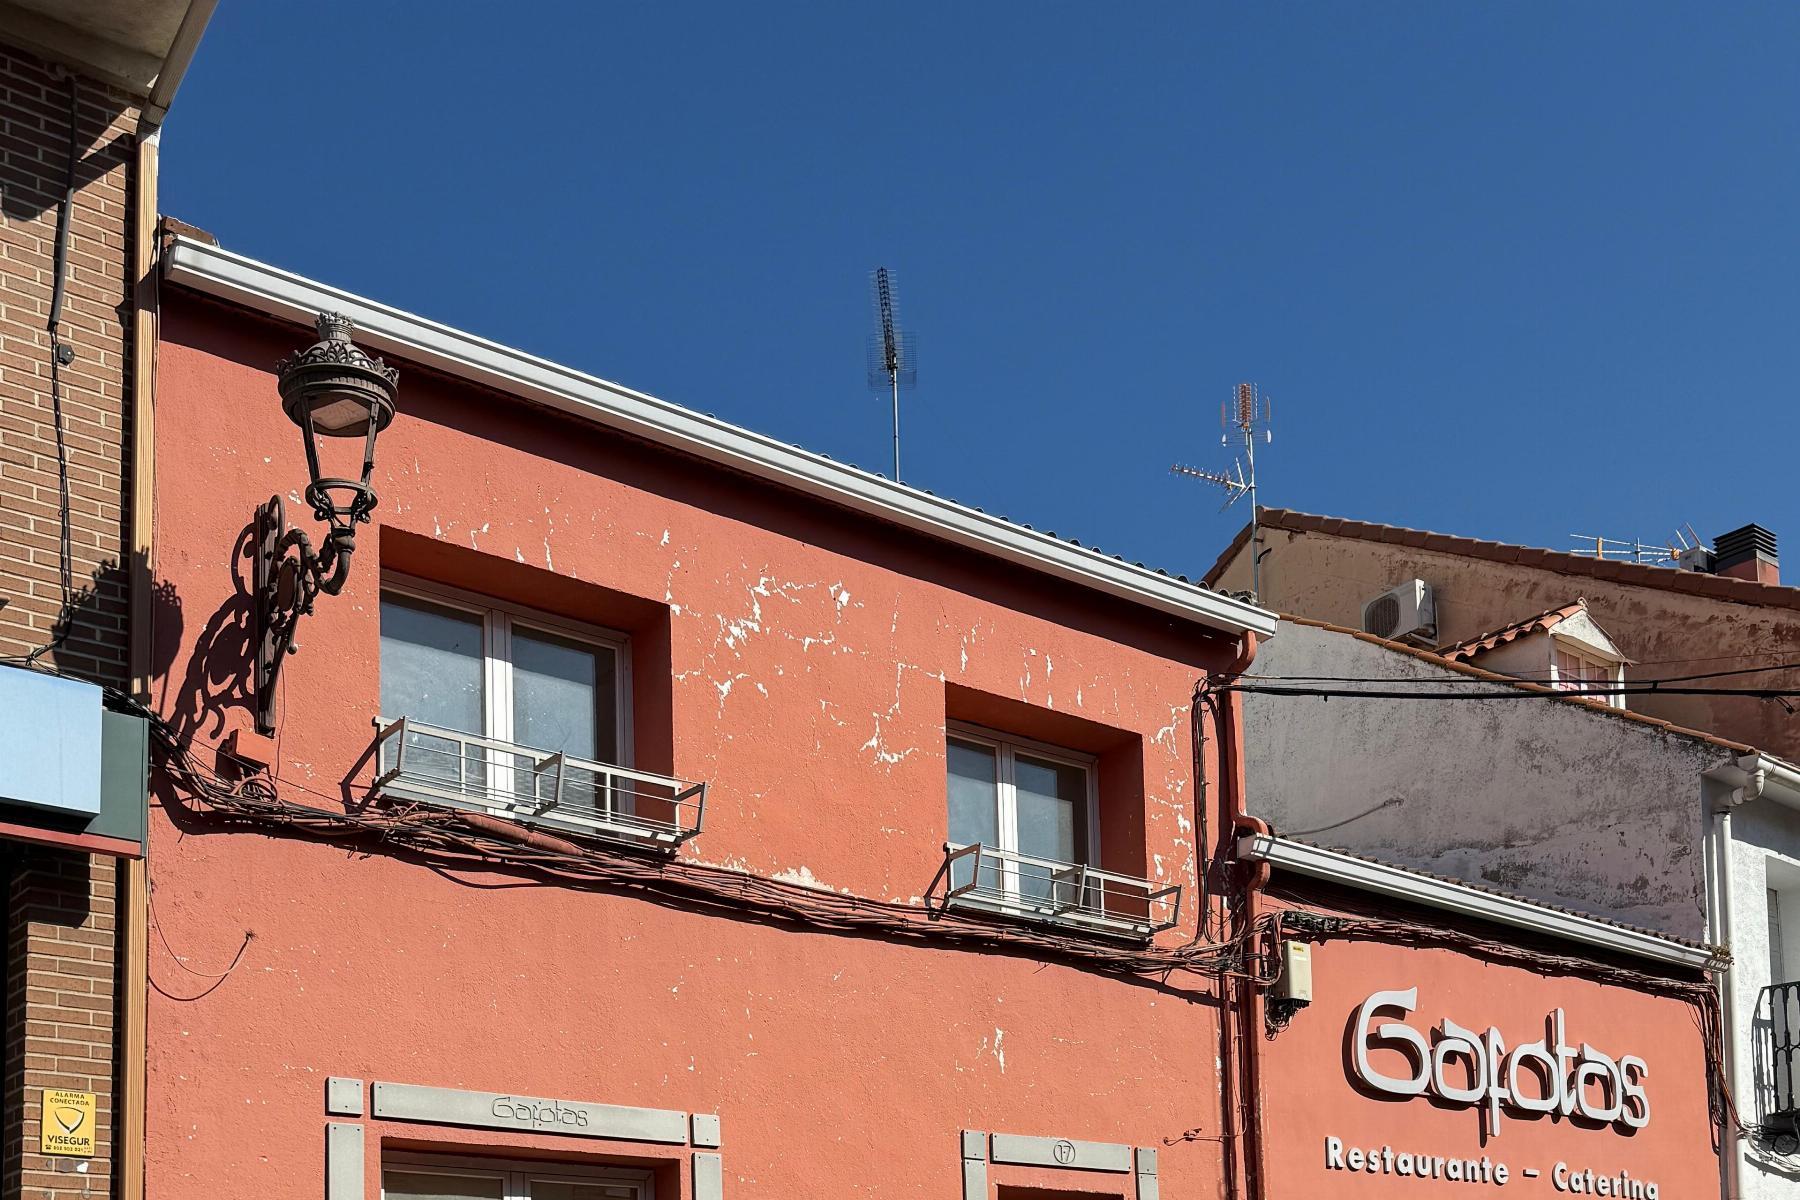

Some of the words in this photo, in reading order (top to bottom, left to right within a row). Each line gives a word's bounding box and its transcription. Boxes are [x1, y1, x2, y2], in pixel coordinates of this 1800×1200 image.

[1353, 987, 1650, 1137] Gafotas
[49, 1098, 89, 1106] CONECTADA
[492, 1096, 588, 1128] Gafotas
[47, 1134, 90, 1146] VISEGUR
[1325, 1136, 1509, 1185] Restaurante
